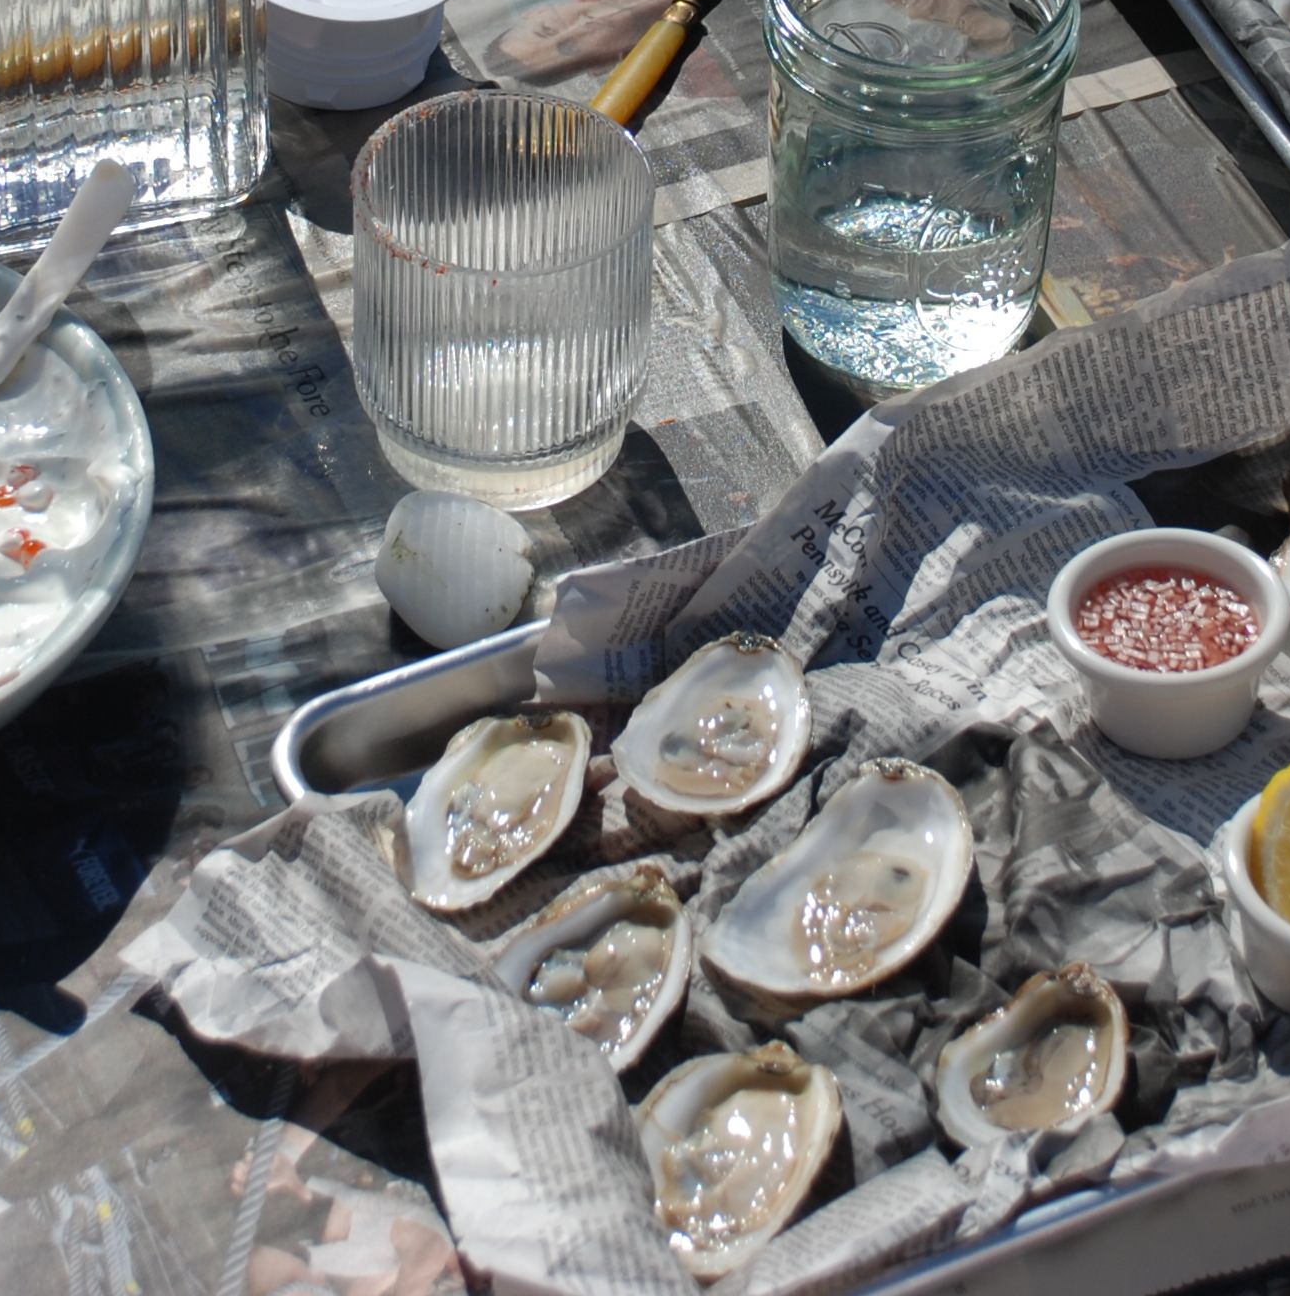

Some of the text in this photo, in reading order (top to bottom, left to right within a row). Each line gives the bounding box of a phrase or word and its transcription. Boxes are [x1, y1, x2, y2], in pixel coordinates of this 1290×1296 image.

[288, 365, 330, 417] Fore
[863, 605, 907, 641] and
[894, 635, 948, 691] Casey
[907, 665, 964, 712] Races
